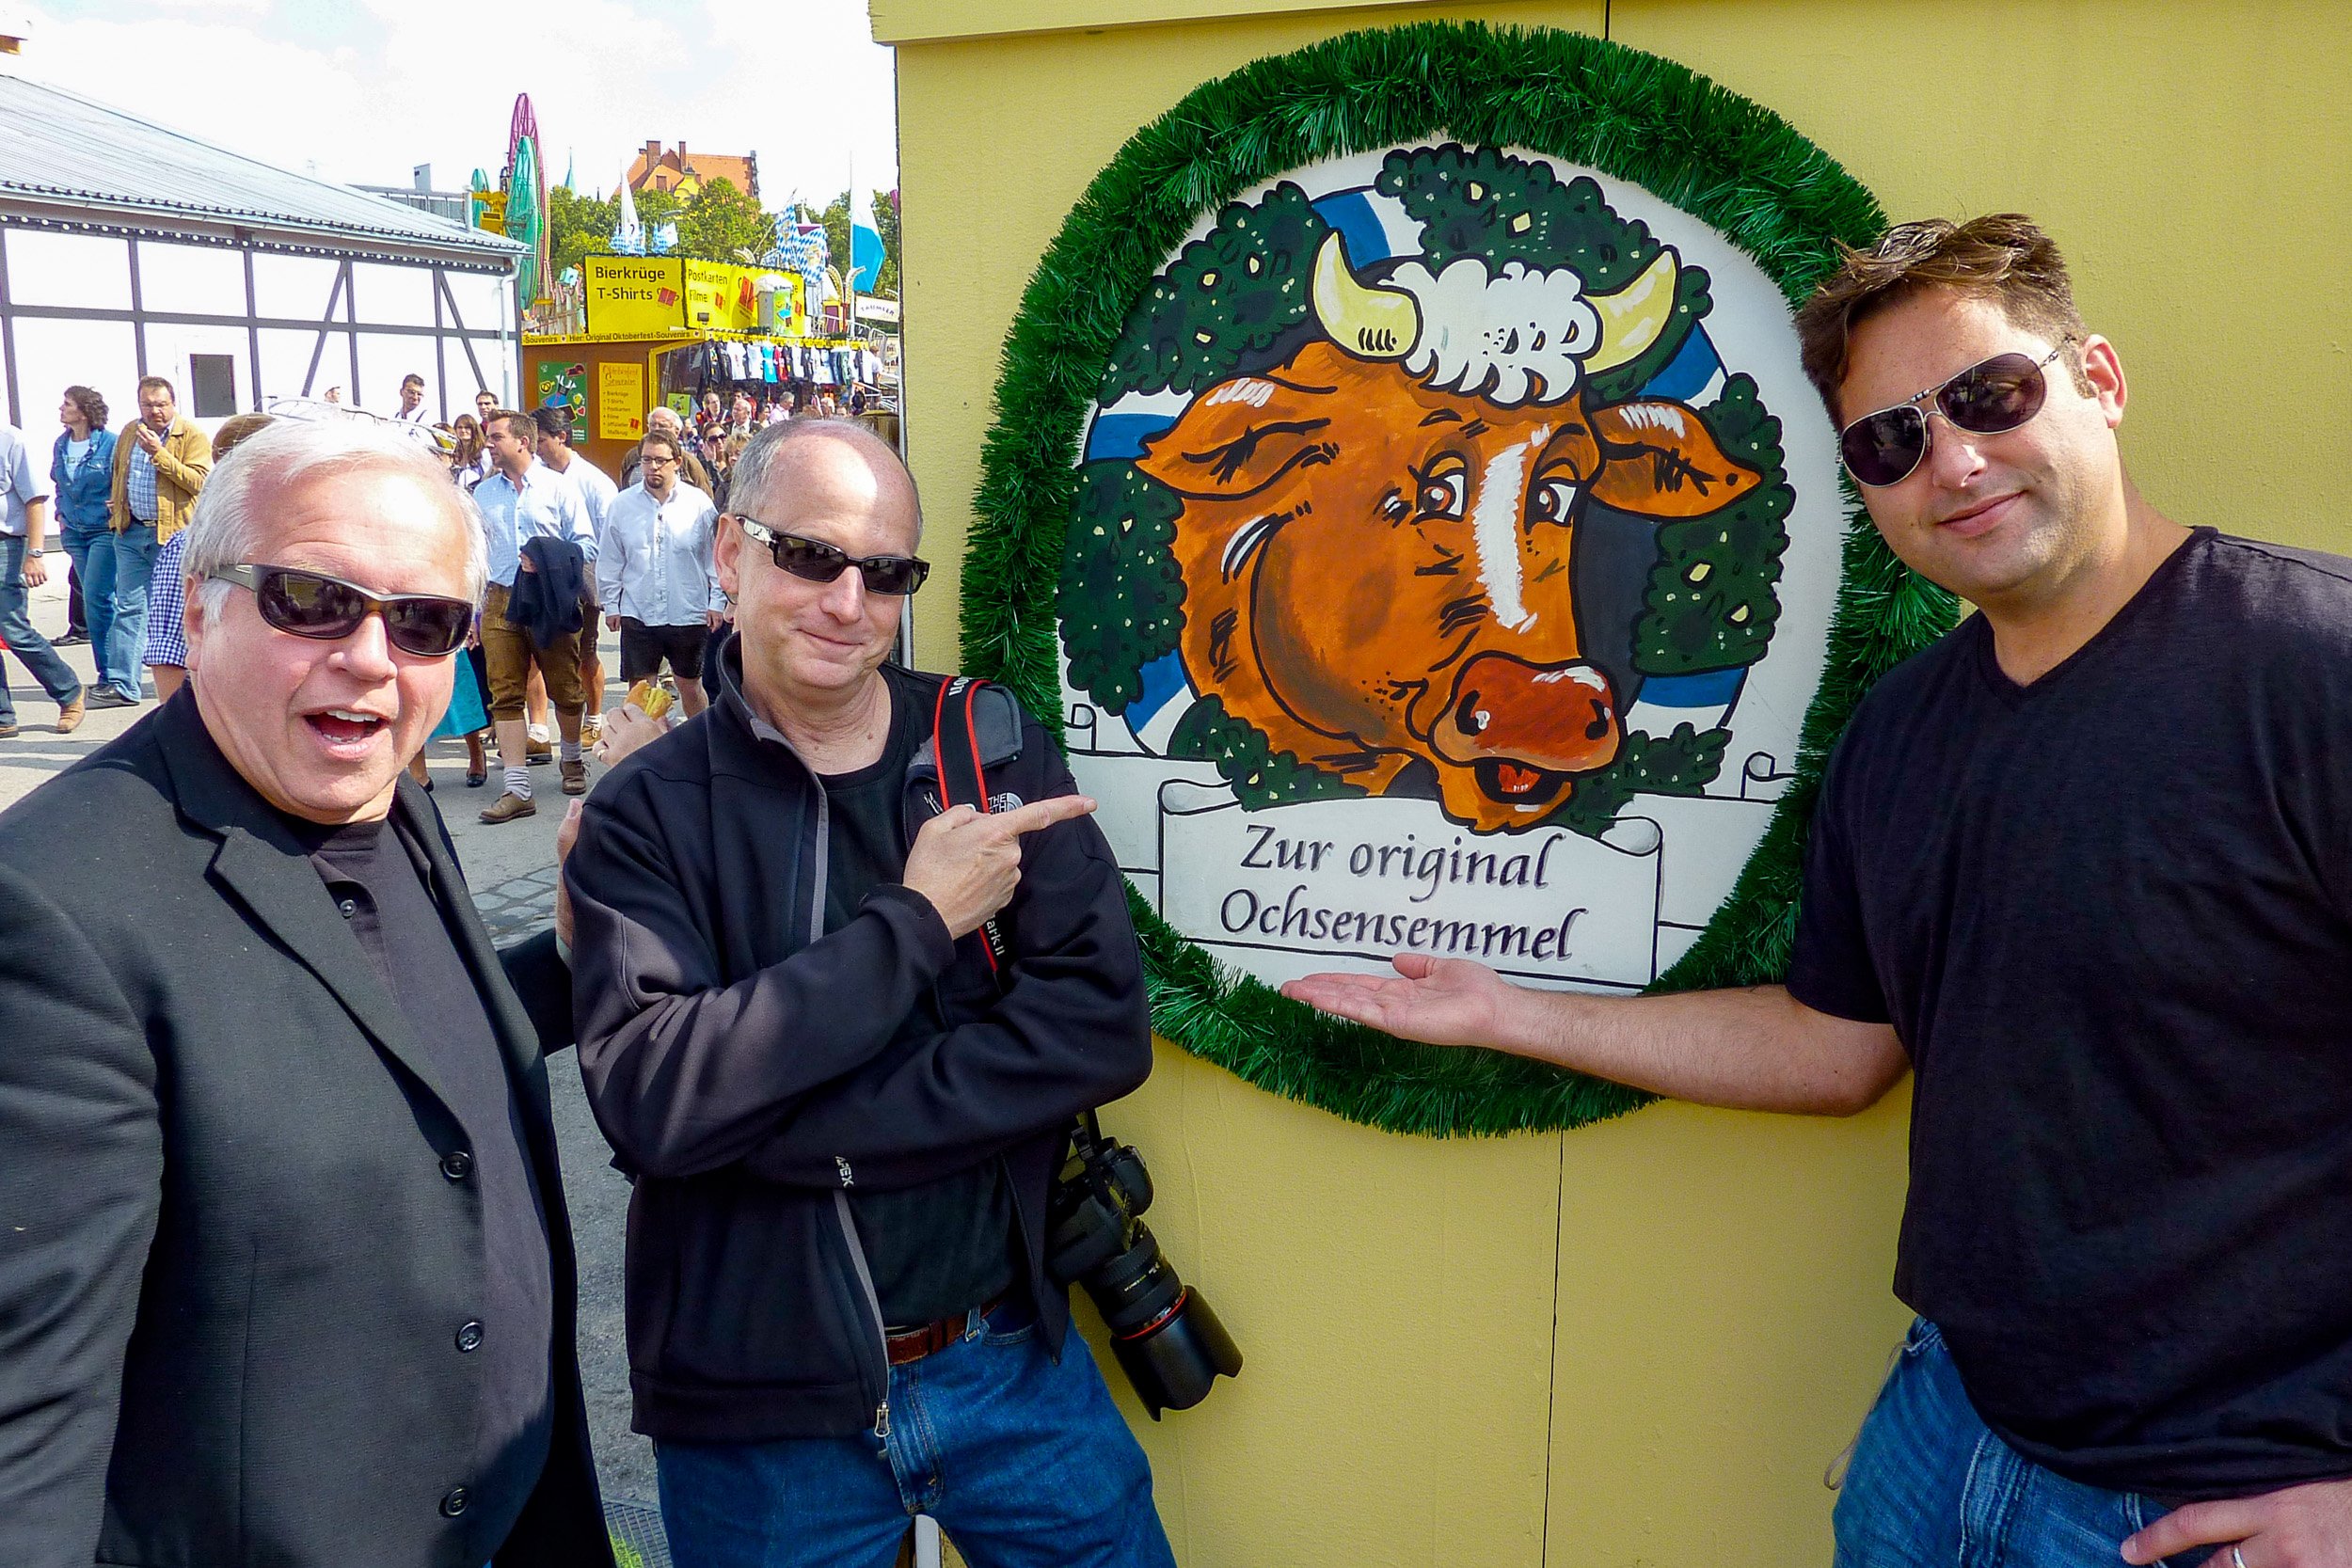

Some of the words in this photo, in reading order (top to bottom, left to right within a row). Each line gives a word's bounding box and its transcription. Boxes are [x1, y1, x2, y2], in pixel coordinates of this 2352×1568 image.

[595, 266, 665, 283] Bierkrüge
[688, 269, 728, 285] Postkarten
[596, 287, 653, 300] T-Shirts
[689, 290, 708, 303] Filme
[585, 333, 612, 343] Original
[612, 331, 691, 341] Oktoberfest-Souvenirs
[987, 793, 1007, 805] THE
[1240, 824, 1335, 872] Zur
[1347, 832, 1566, 902] original
[986, 914, 1001, 945] ark
[1219, 886, 1588, 960] Ochsensemmel
